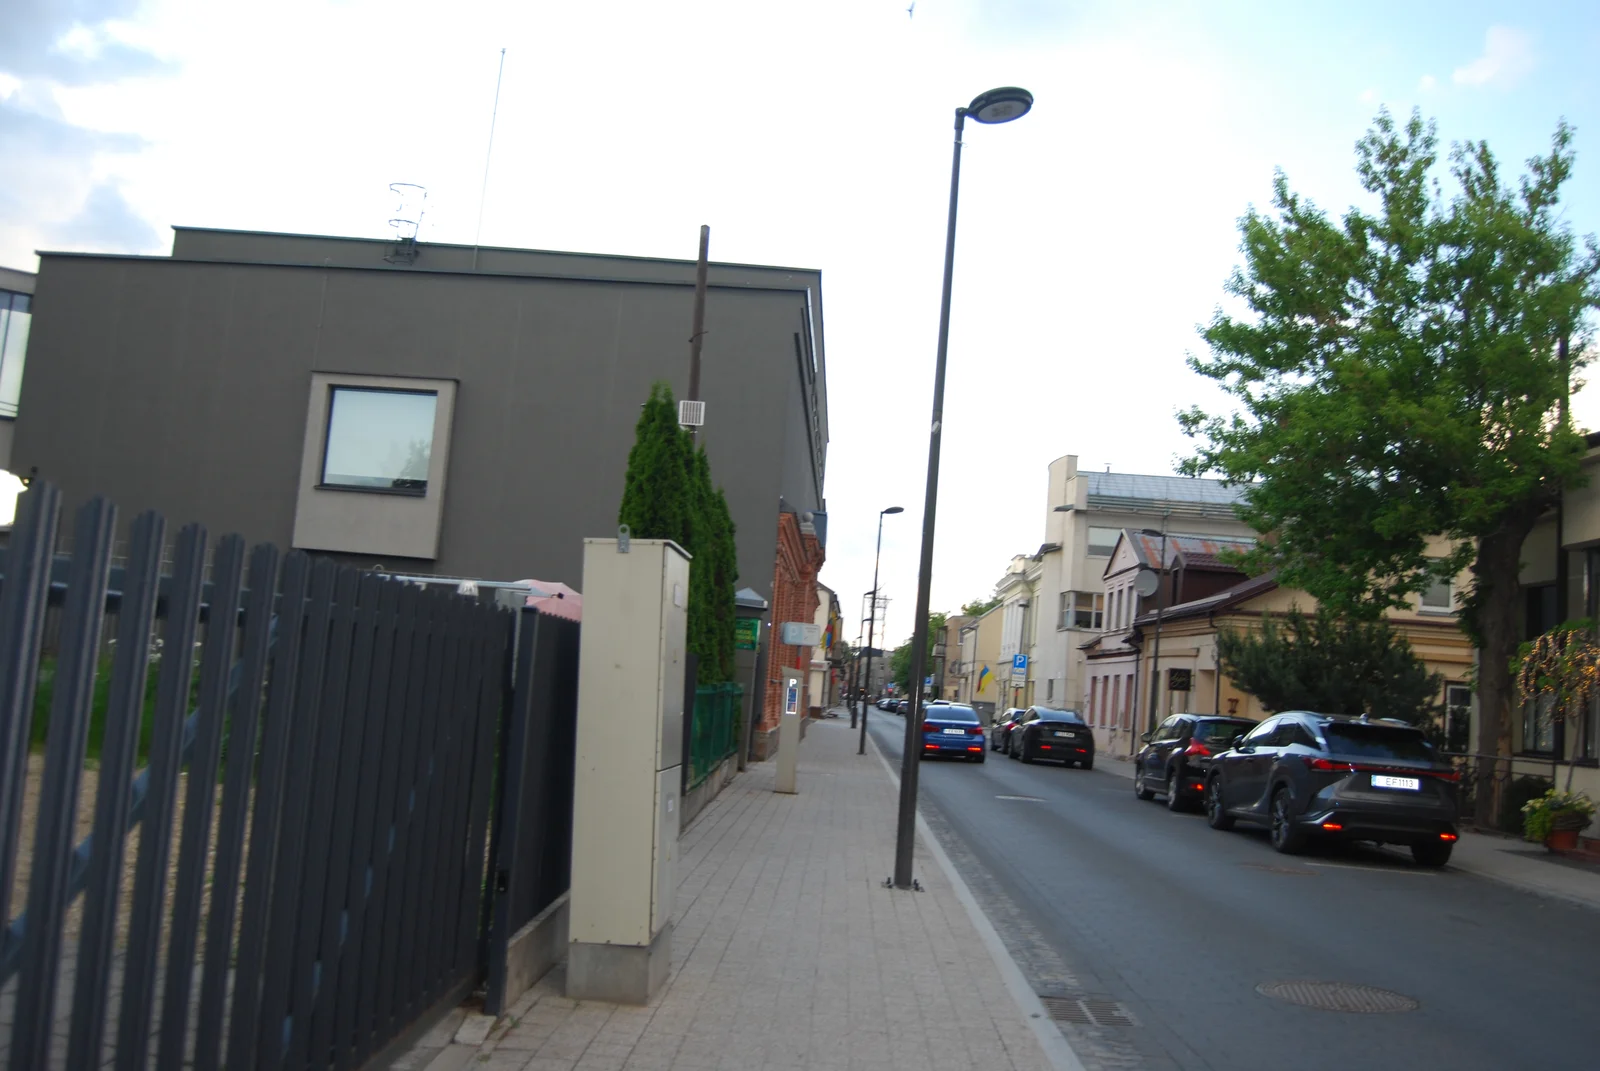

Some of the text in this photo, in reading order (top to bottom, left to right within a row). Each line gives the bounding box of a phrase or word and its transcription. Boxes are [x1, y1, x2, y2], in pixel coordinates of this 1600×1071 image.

[1016, 655, 1025, 666] P
[789, 678, 797, 687] P
[1386, 778, 1413, 788] EF1113
